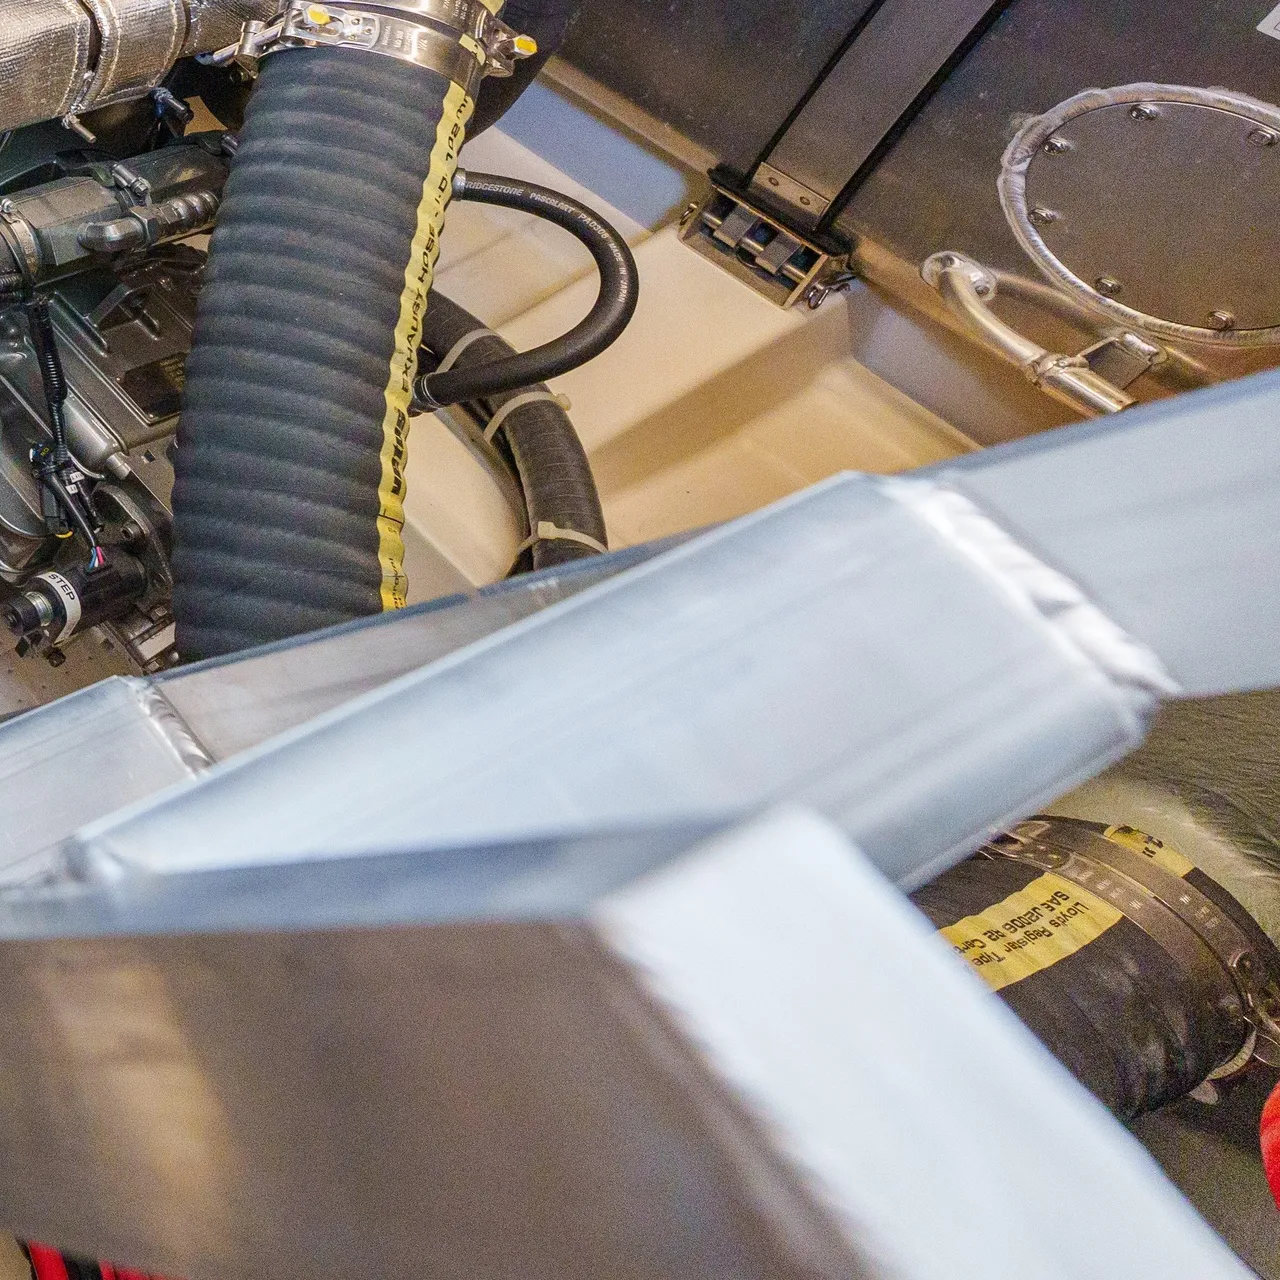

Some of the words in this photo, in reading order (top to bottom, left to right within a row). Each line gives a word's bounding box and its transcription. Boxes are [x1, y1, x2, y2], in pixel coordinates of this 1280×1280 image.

[381, 24, 391, 45] NORMA
[401, 288, 425, 393] EXHAUST
[417, 223, 437, 284] HOSE
[445, 125, 460, 161] 102
[608, 242, 625, 262] MADE
[619, 267, 628, 275] IN
[618, 279, 628, 303] JAPAN
[48, 573, 75, 602] STEP
[1040, 890, 1070, 912] SAE
[1002, 906, 1043, 934] J2006
[1049, 901, 1090, 928] Lloyd's
[1005, 925, 1054, 953] Register
[973, 950, 1006, 967] Type
